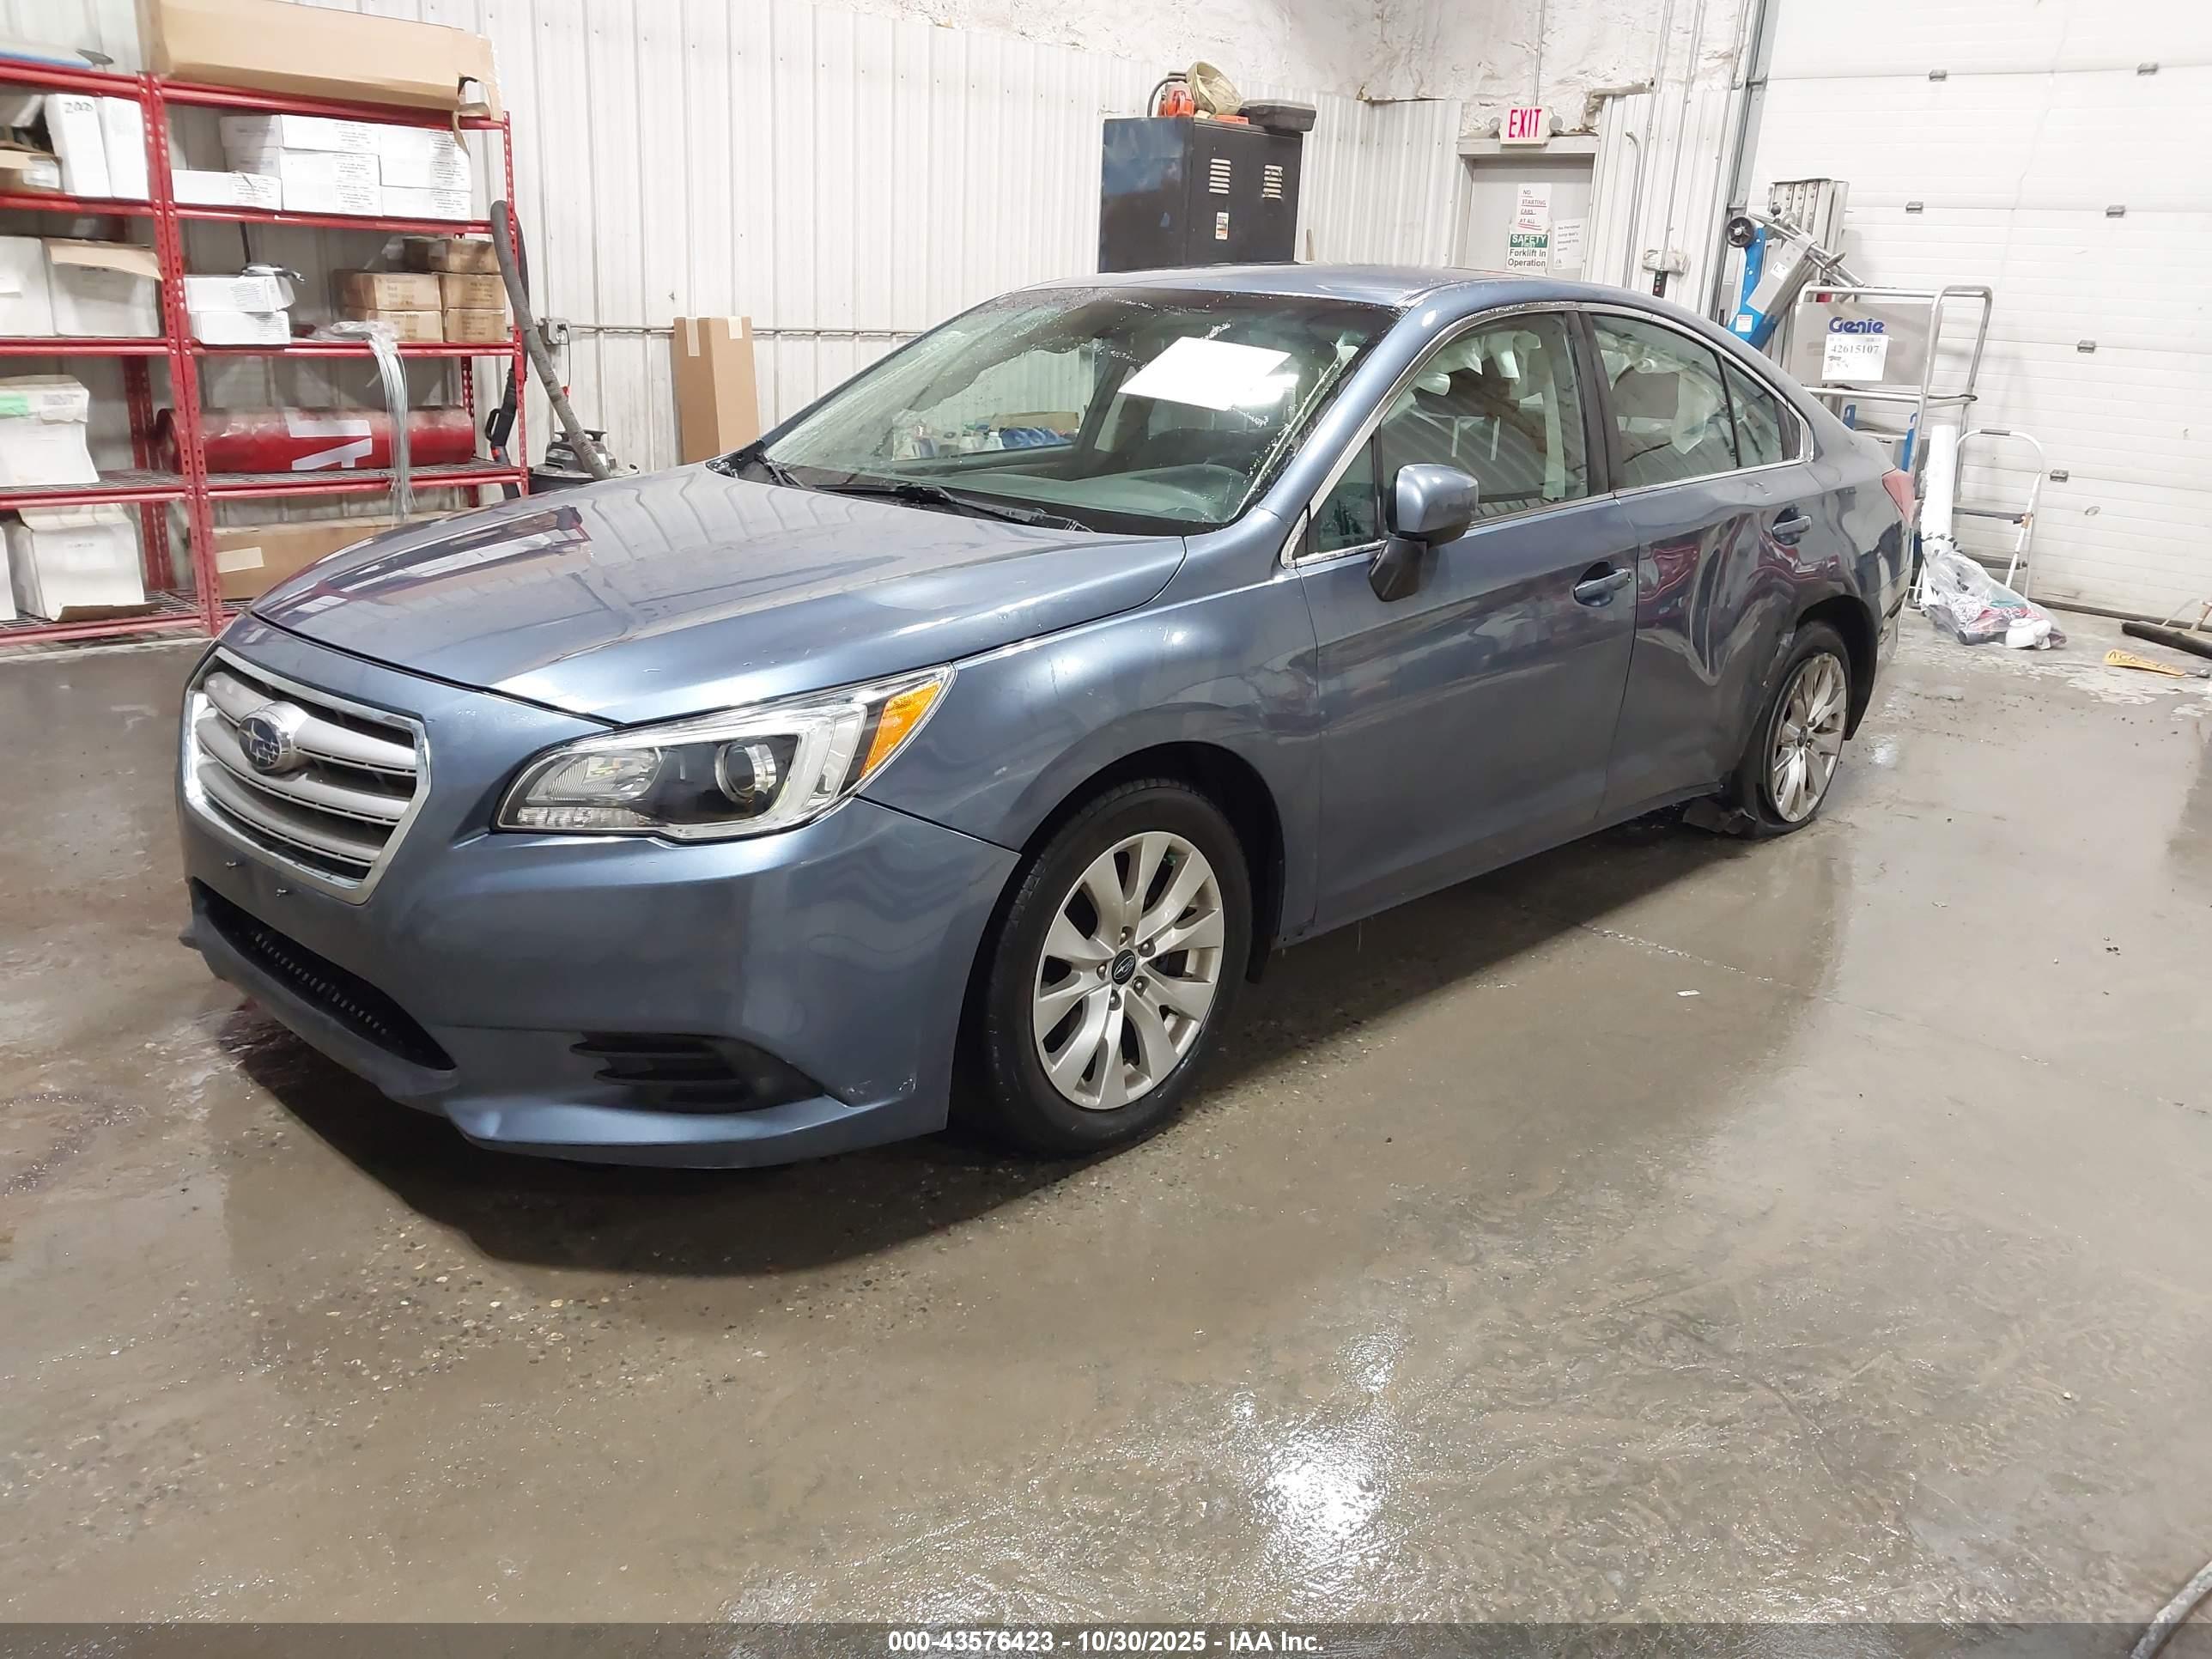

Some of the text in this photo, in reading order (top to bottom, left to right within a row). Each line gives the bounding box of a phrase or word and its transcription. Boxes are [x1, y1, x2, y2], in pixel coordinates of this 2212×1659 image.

[1509, 108, 1542, 137] EXIT
[1511, 234, 1547, 244] SAFETY
[1509, 248, 1537, 257] Forklift
[1507, 258, 1547, 268] Operation
[1829, 316, 1885, 334] Genie
[1831, 344, 1880, 355] 42615107
